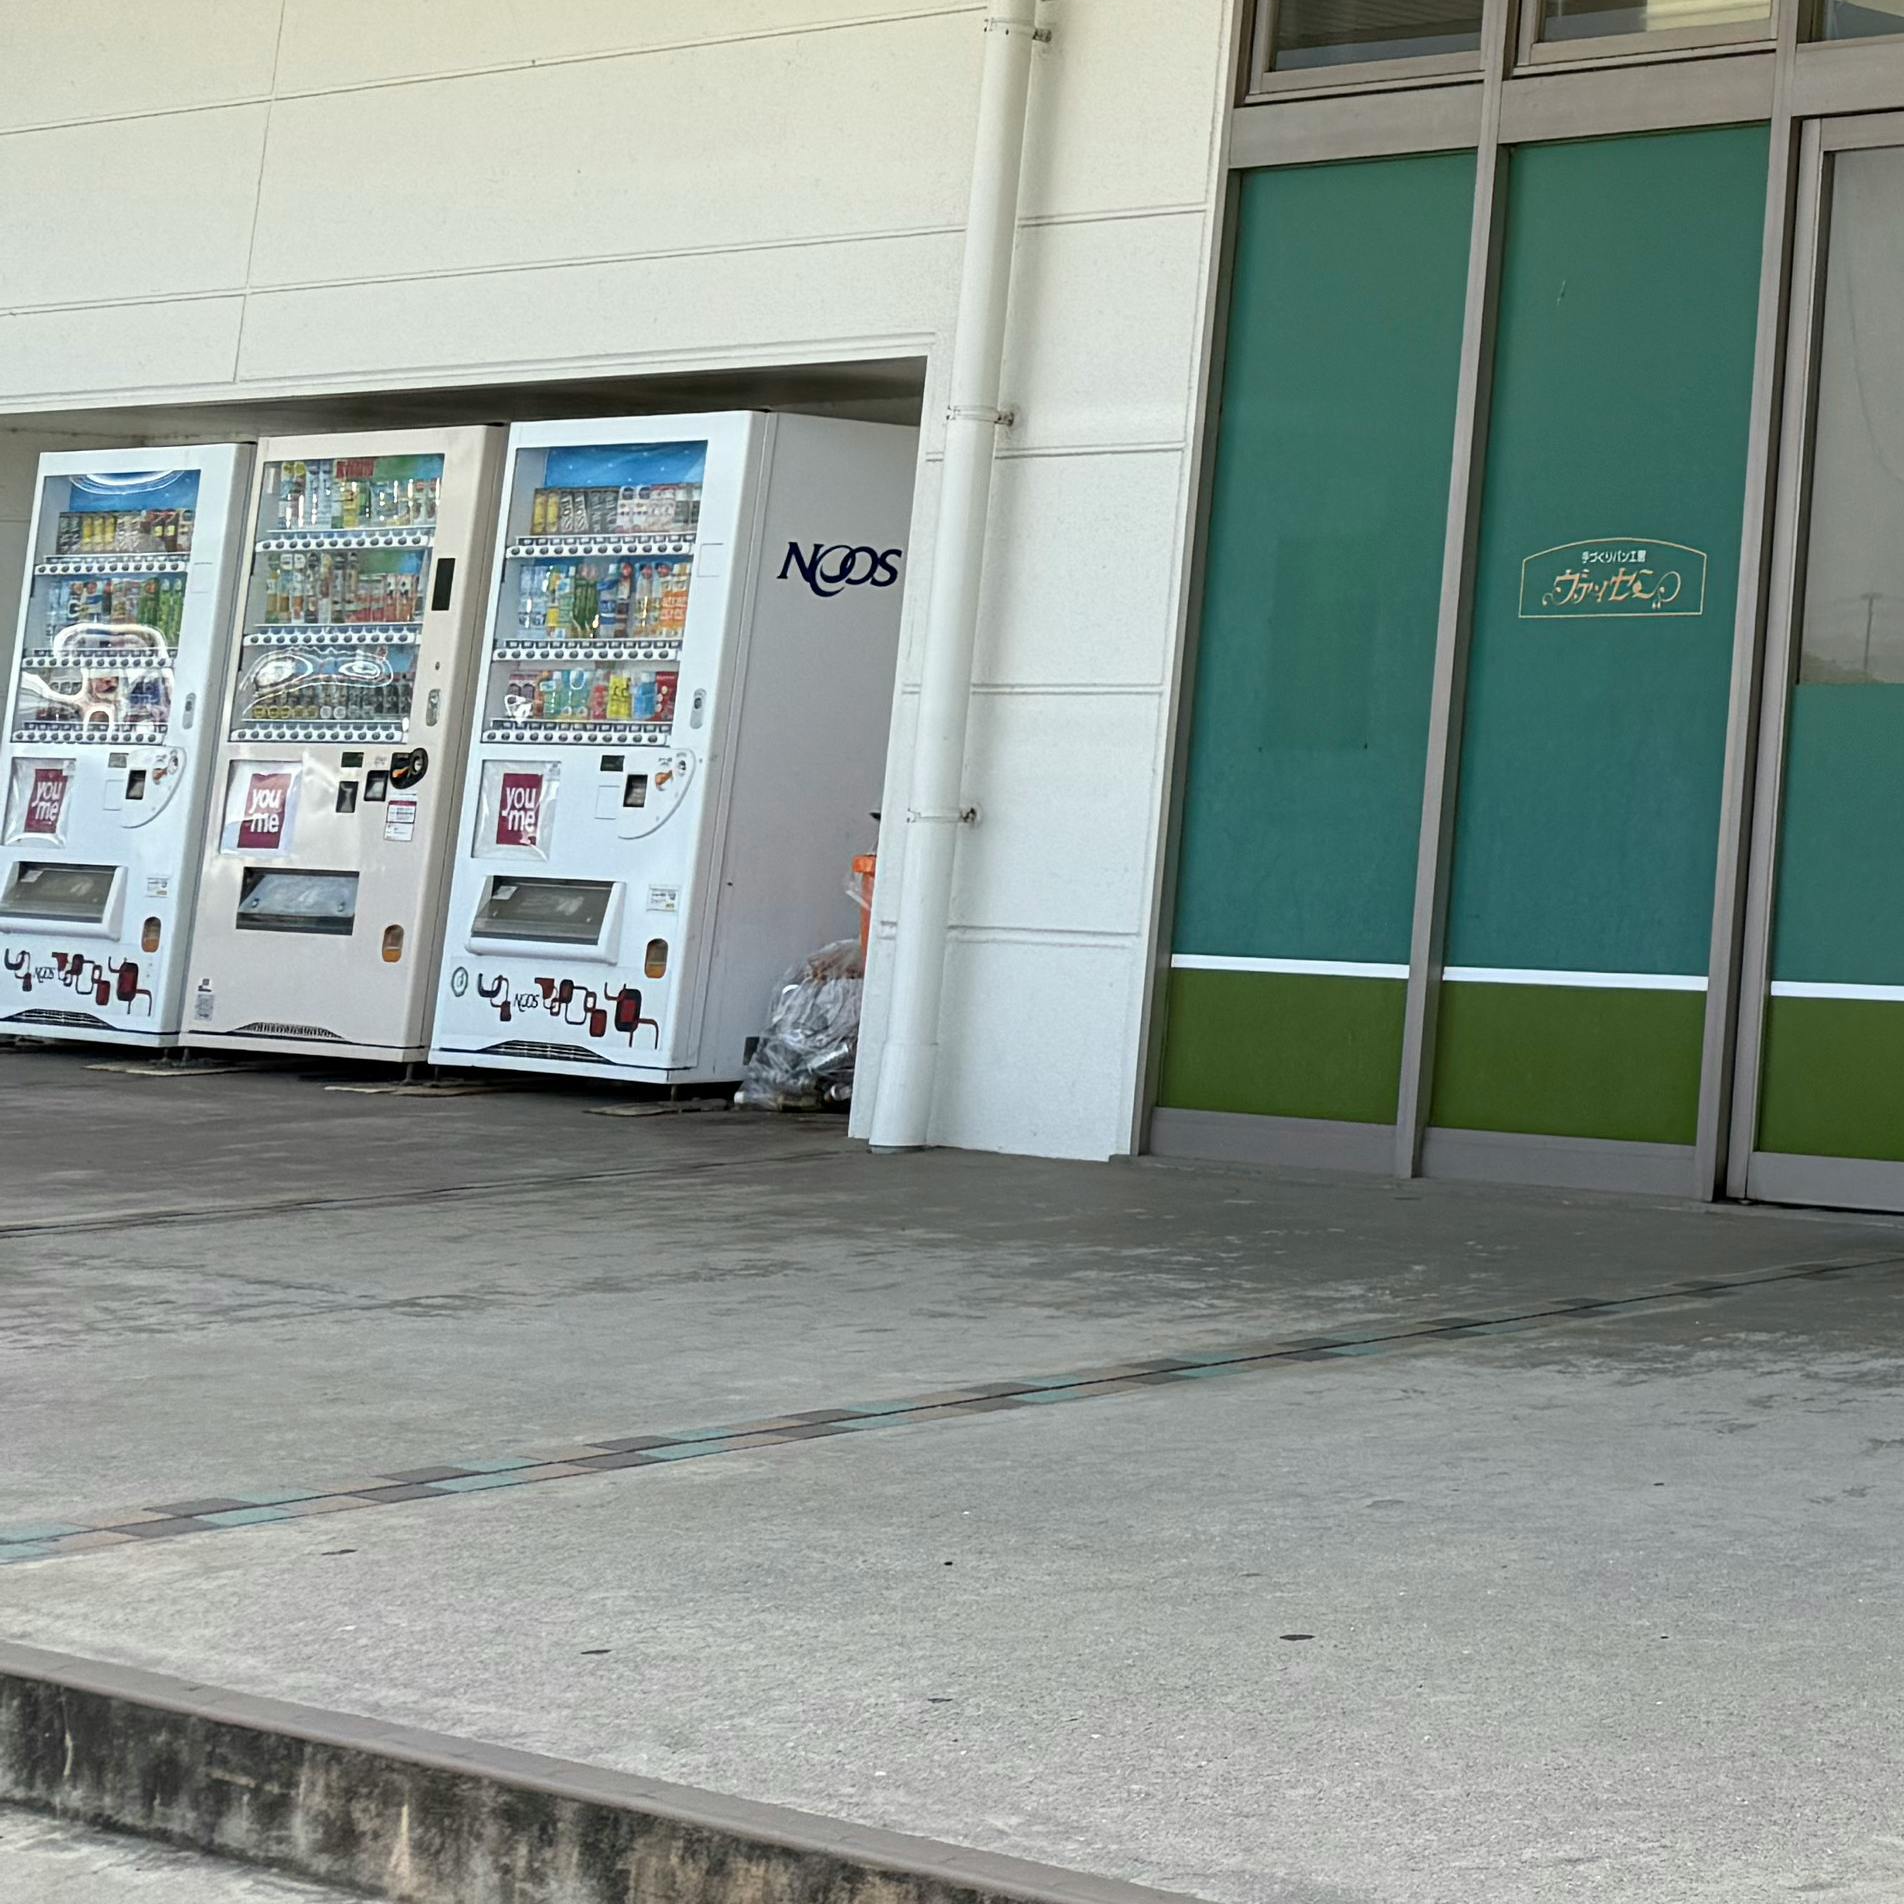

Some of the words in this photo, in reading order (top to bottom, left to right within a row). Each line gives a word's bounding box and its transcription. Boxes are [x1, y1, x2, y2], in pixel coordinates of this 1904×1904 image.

[31, 781, 62, 807] you
[248, 788, 282, 814] you
[501, 786, 537, 816] you
[35, 801, 59, 821] me
[250, 812, 280, 833] me
[508, 810, 536, 833] me
